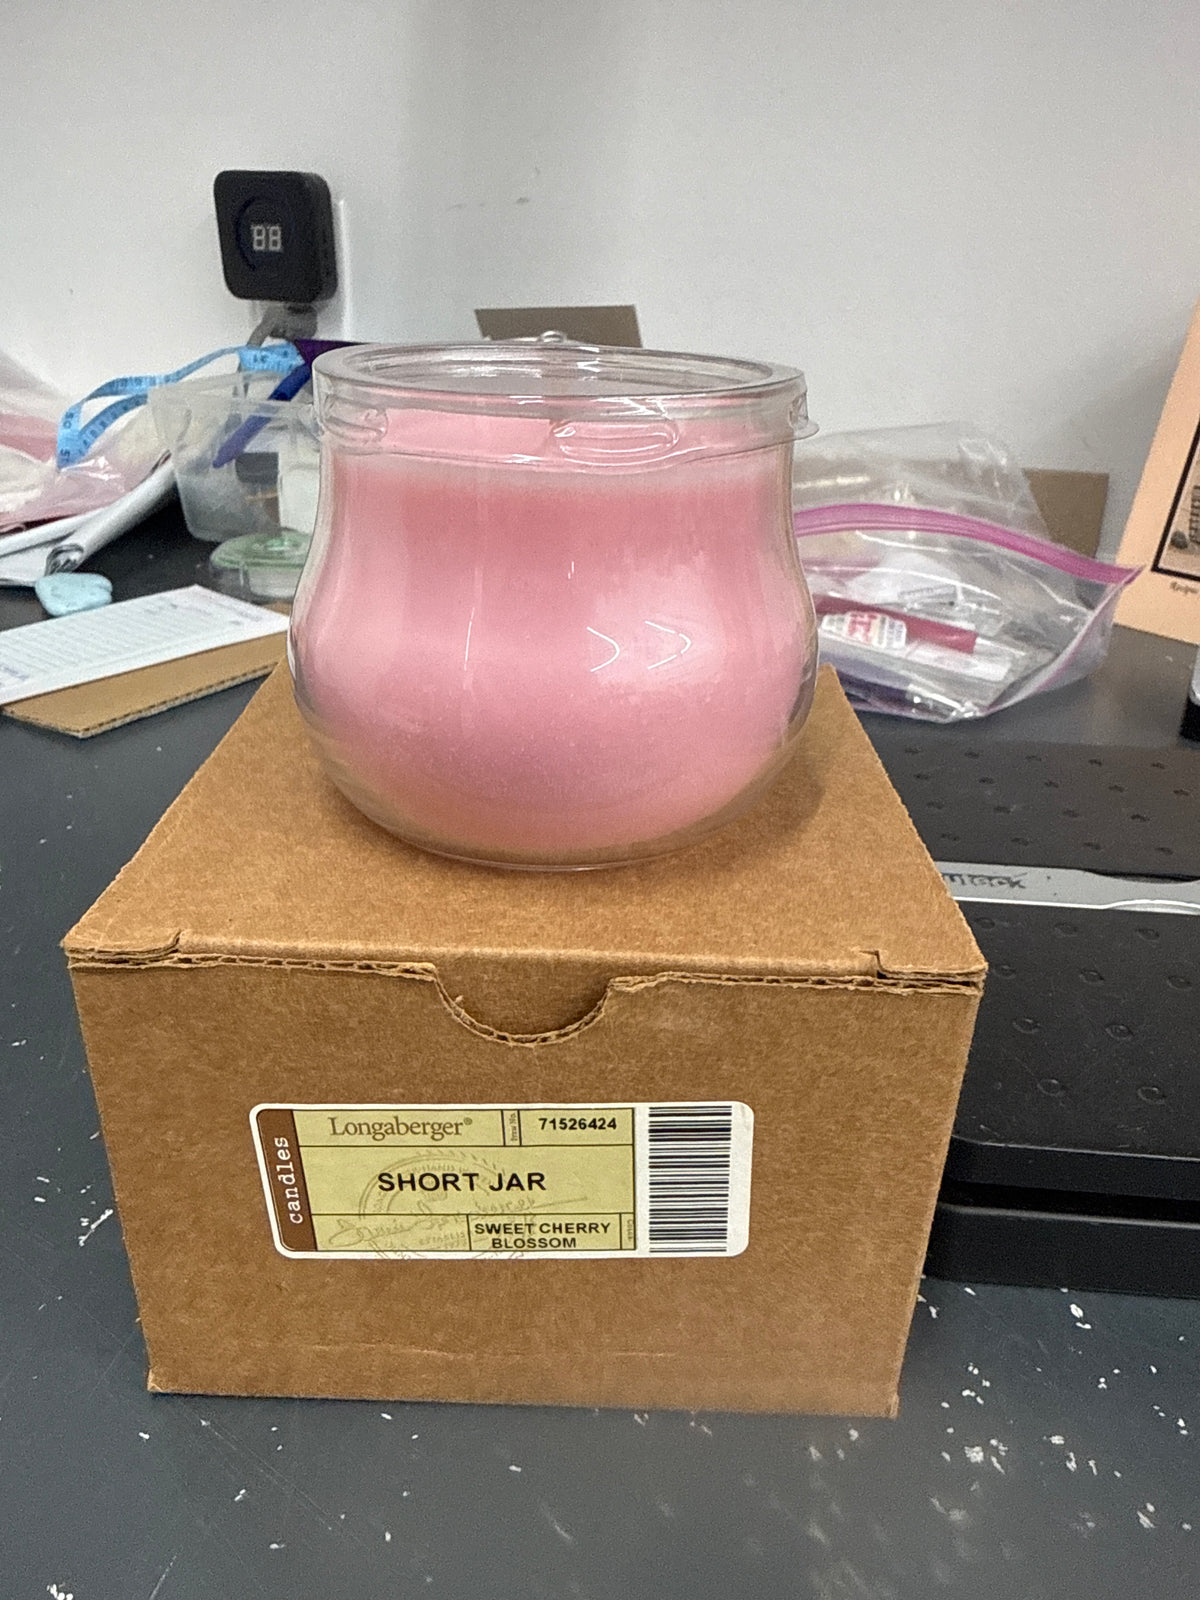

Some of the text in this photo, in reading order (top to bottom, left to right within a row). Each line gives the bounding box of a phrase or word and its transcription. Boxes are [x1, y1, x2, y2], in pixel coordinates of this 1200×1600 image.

[538, 1117, 617, 1131] 71526424
[273, 1136, 304, 1225] candles
[377, 1171, 547, 1192] SHORT JAR
[474, 1222, 535, 1235] SWEET
[538, 1222, 612, 1235] CHERRY
[491, 1237, 577, 1249] BLOSSOM
